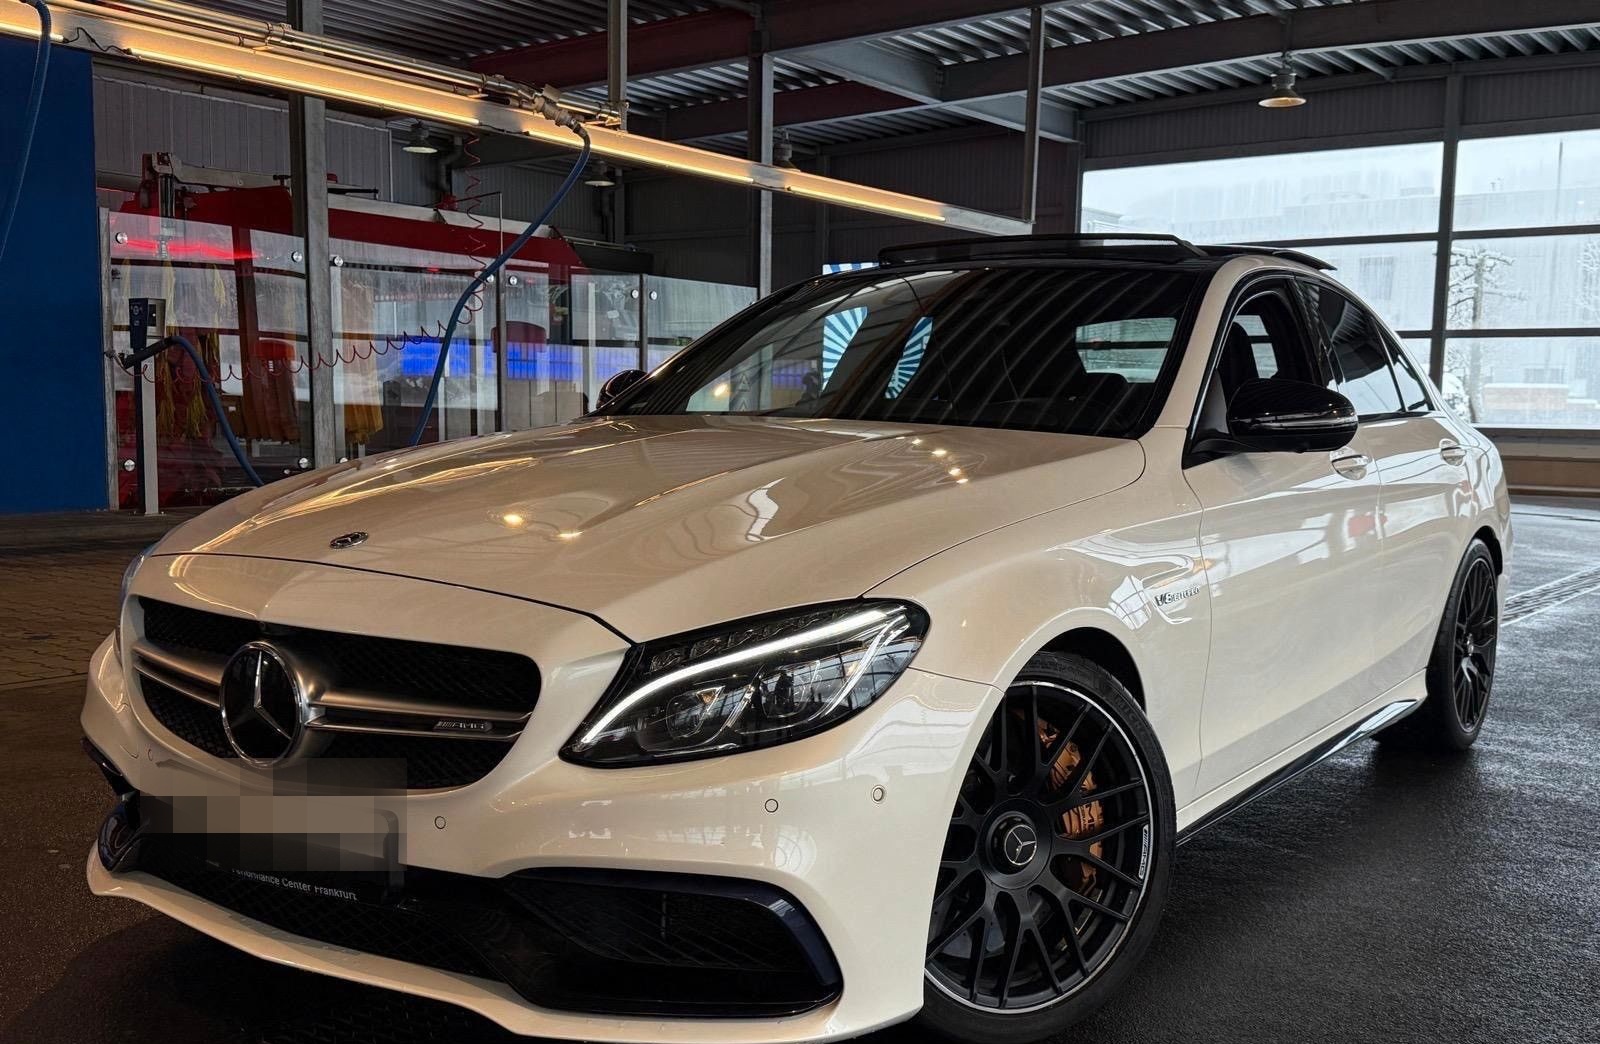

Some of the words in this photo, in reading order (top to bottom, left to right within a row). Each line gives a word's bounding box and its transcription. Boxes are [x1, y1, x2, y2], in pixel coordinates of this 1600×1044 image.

[232, 869, 280, 885] erformance
[282, 878, 311, 892] Center
[314, 886, 357, 901] Frankfurt
